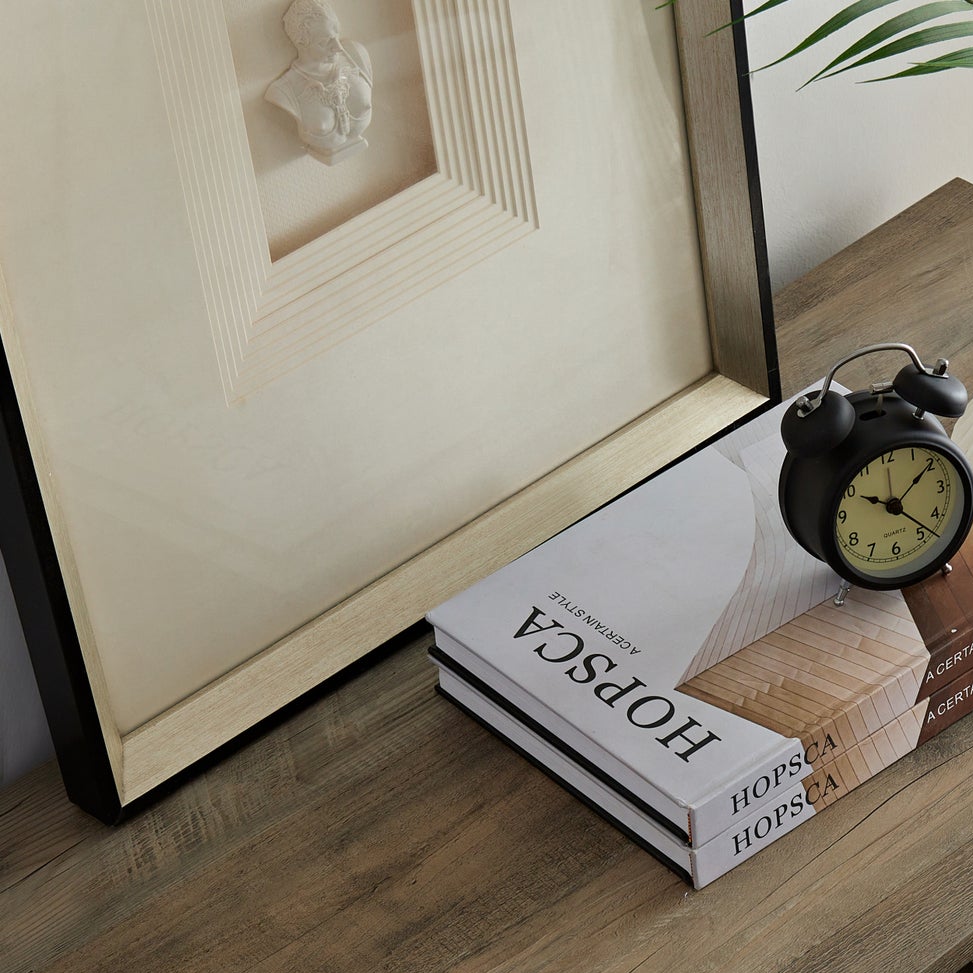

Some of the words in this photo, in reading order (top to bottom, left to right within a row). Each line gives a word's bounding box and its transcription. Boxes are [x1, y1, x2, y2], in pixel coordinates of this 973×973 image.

[926, 457, 935, 472] 2
[936, 480, 945, 493] 3
[838, 510, 847, 524] 9
[930, 506, 940, 519] 4
[848, 532, 859, 546] 8
[884, 528, 906, 538] QUARTZ
[916, 526, 925, 541] 5
[867, 543, 876, 557] 7
[891, 541, 901, 555] 6
[513, 605, 722, 763] HOPSCA
[925, 671, 935, 684] A
[927, 711, 936, 724] A
[730, 733, 838, 816] HOPSCA
[731, 773, 839, 857] HOPSCA
